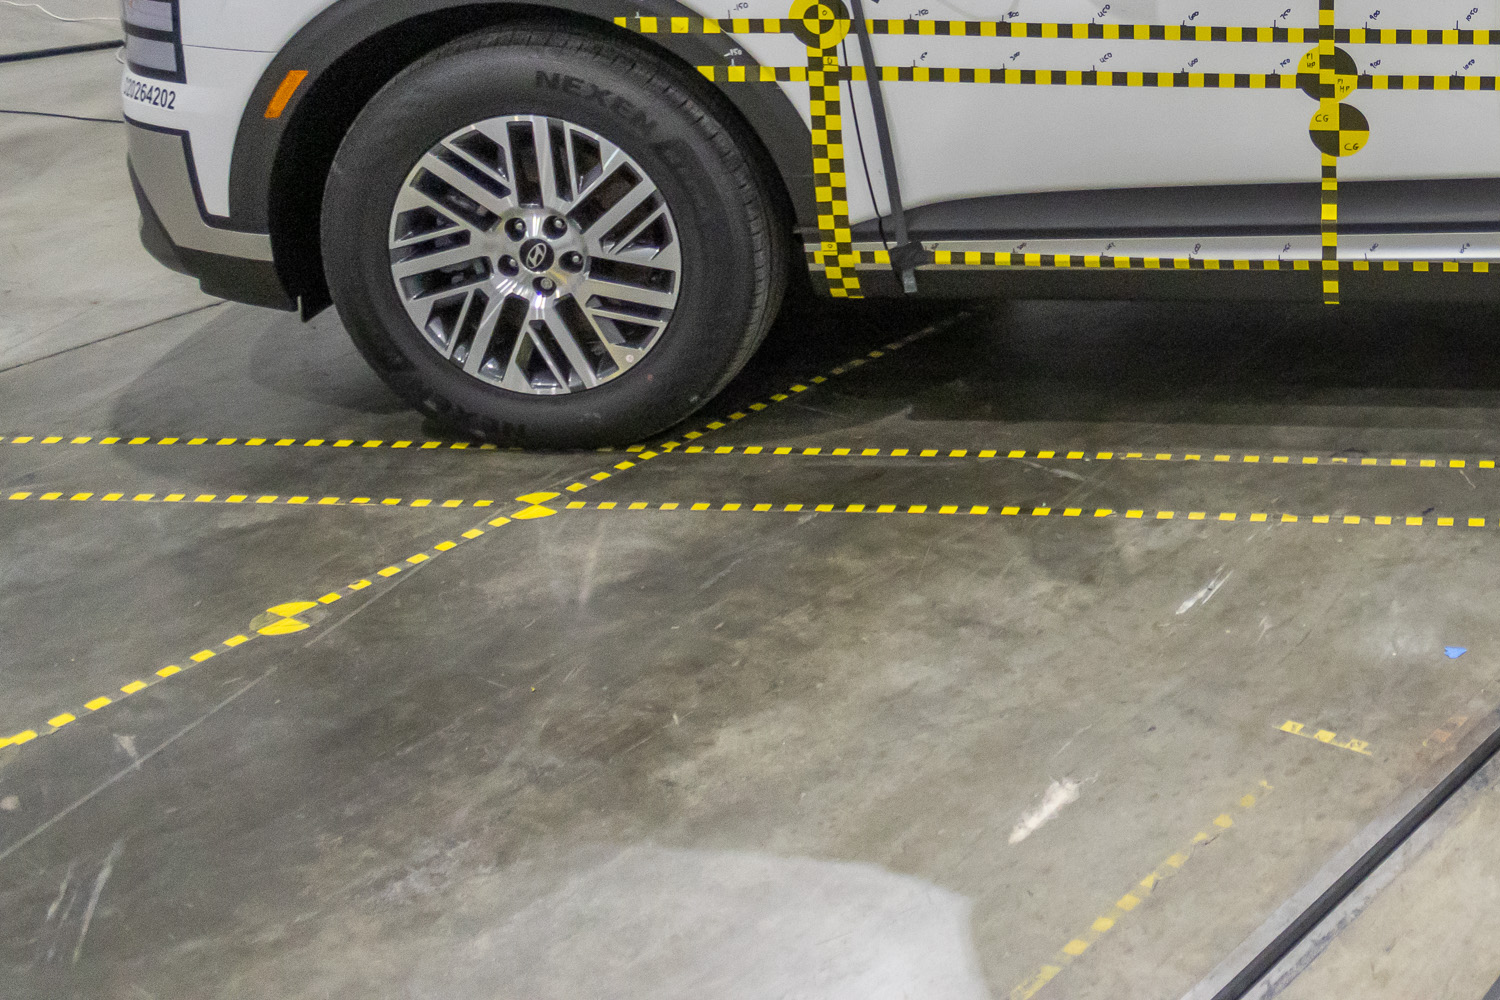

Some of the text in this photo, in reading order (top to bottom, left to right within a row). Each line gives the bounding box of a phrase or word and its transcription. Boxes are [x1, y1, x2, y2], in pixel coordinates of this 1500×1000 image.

[733, 2, 749, 12] -150
[1096, 4, 1111, 18] 450
[535, 70, 658, 138] NEXEN
[1315, 114, 1329, 123] CG
[1344, 142, 1360, 151] CG
